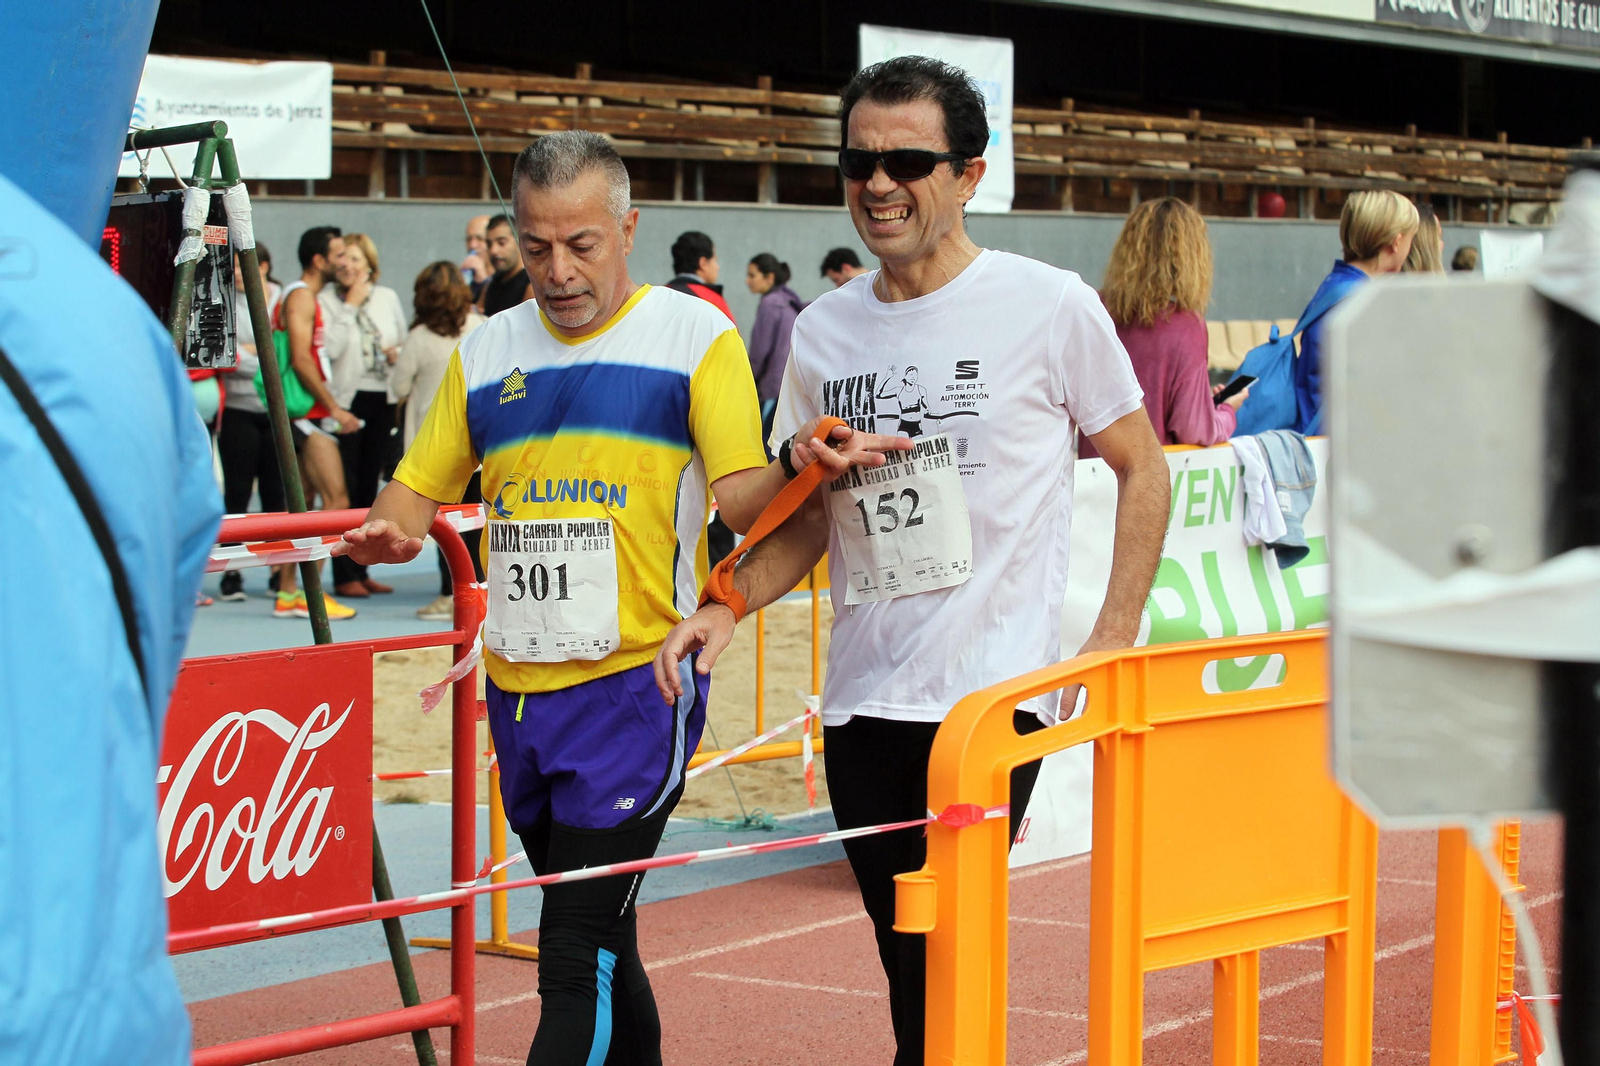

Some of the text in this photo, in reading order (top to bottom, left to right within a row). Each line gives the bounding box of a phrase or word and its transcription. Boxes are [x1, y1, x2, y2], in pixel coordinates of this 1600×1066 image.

[1561, 0, 1577, 30] DE
[1578, 3, 1600, 33] CAL
[155, 99, 324, 121] Ayuntamiento de Jerez
[499, 389, 527, 405] luanvi
[940, 393, 990, 402] AUTOMOCIÓN
[945, 384, 987, 392] SEAT
[953, 401, 977, 409] TERRY
[905, 437, 950, 462] POPULAR
[864, 465, 900, 485] CIUDAD
[905, 462, 916, 476] DE
[922, 454, 953, 472] JEREZ
[855, 487, 924, 537] 152
[490, 523, 521, 552] XXXIX
[523, 524, 563, 539] CARRERA
[567, 522, 610, 539] POPULAR
[523, 538, 611, 553] CIUDAD DE JEREZ
[507, 563, 573, 602] 301
